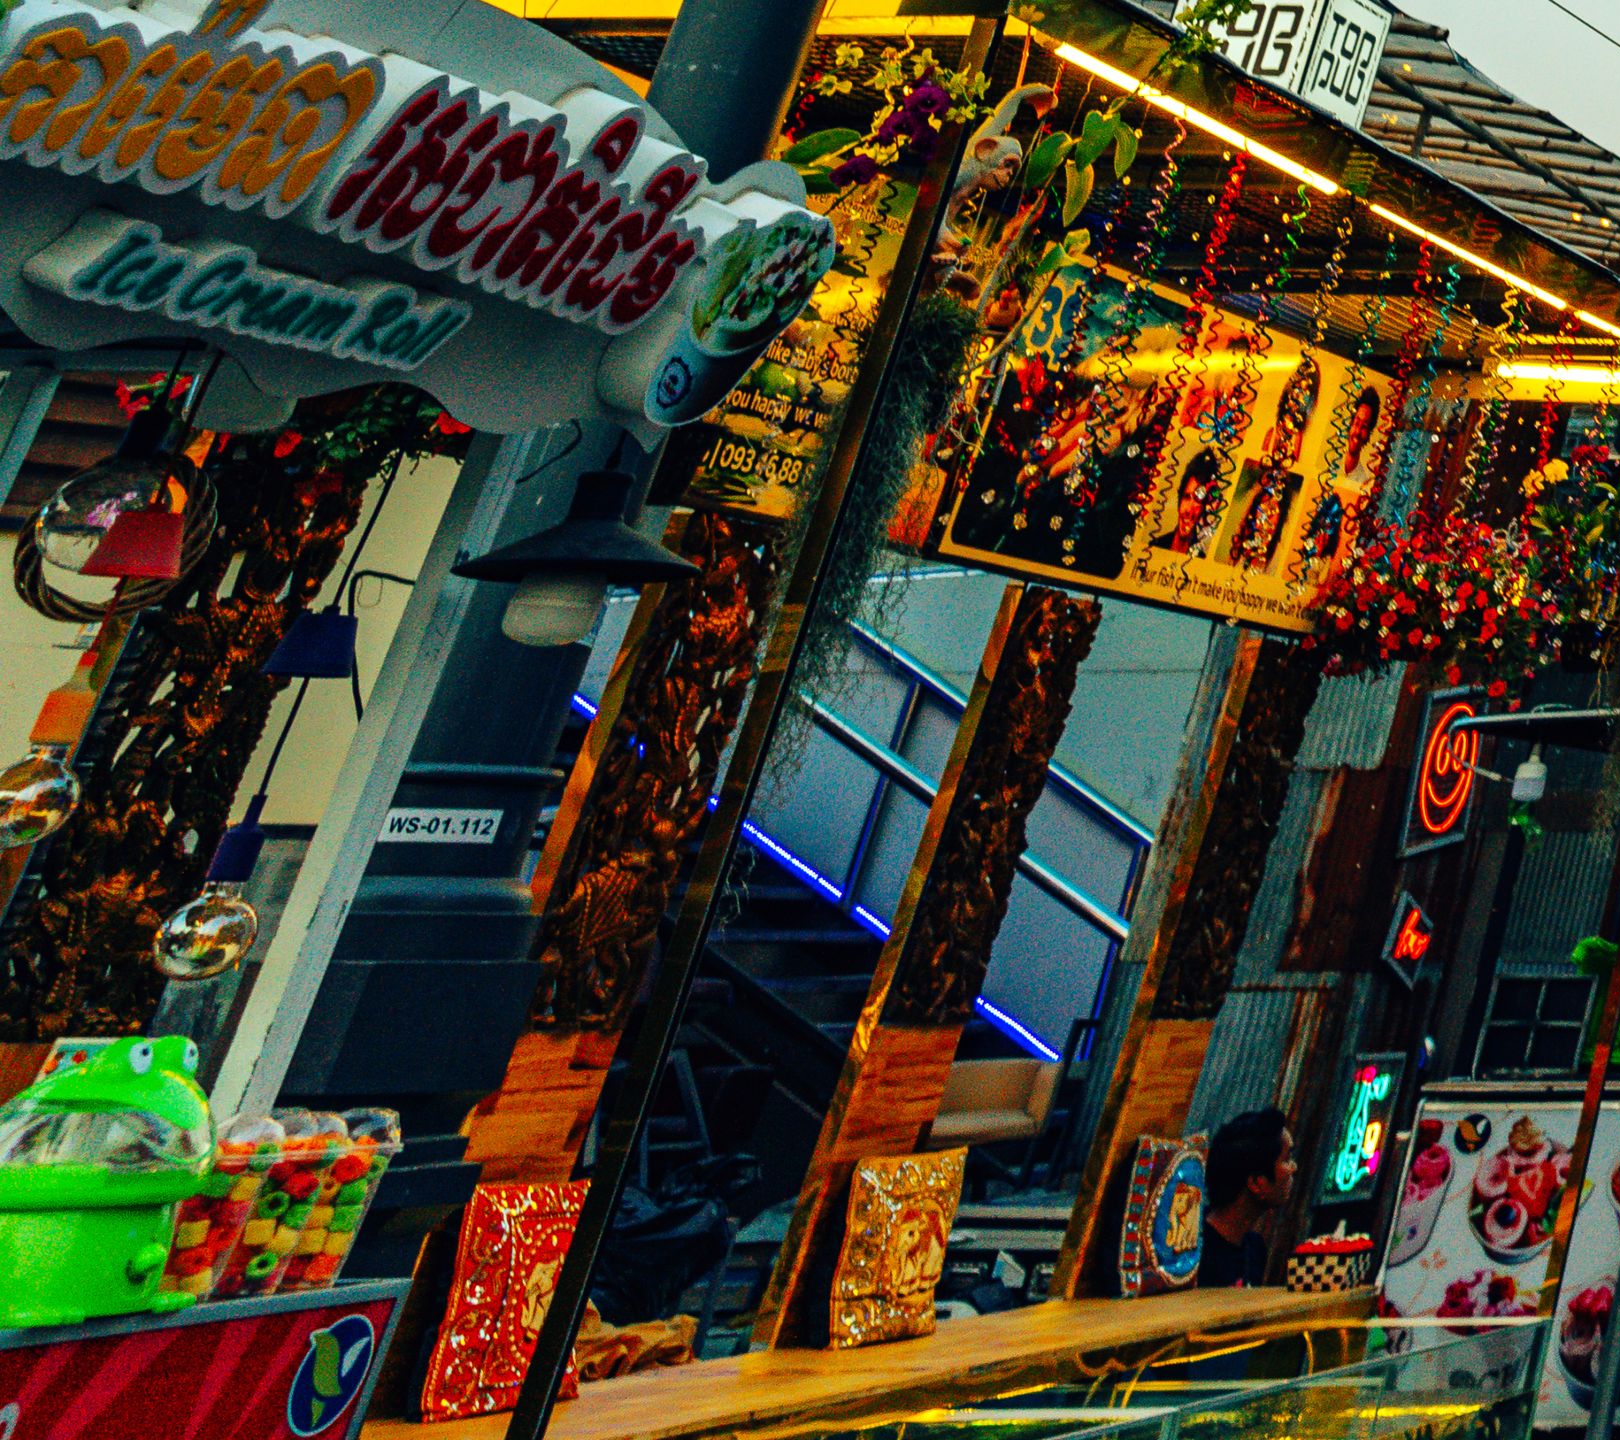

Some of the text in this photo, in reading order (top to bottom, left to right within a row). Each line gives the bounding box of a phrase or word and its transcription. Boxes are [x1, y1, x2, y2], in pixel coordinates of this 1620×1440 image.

[1332, 11, 1376, 69] TOP
[1311, 49, 1366, 106] PUB
[74, 232, 468, 365] Ice Cream Roll
[389, 816, 495, 836] WS-01.112
